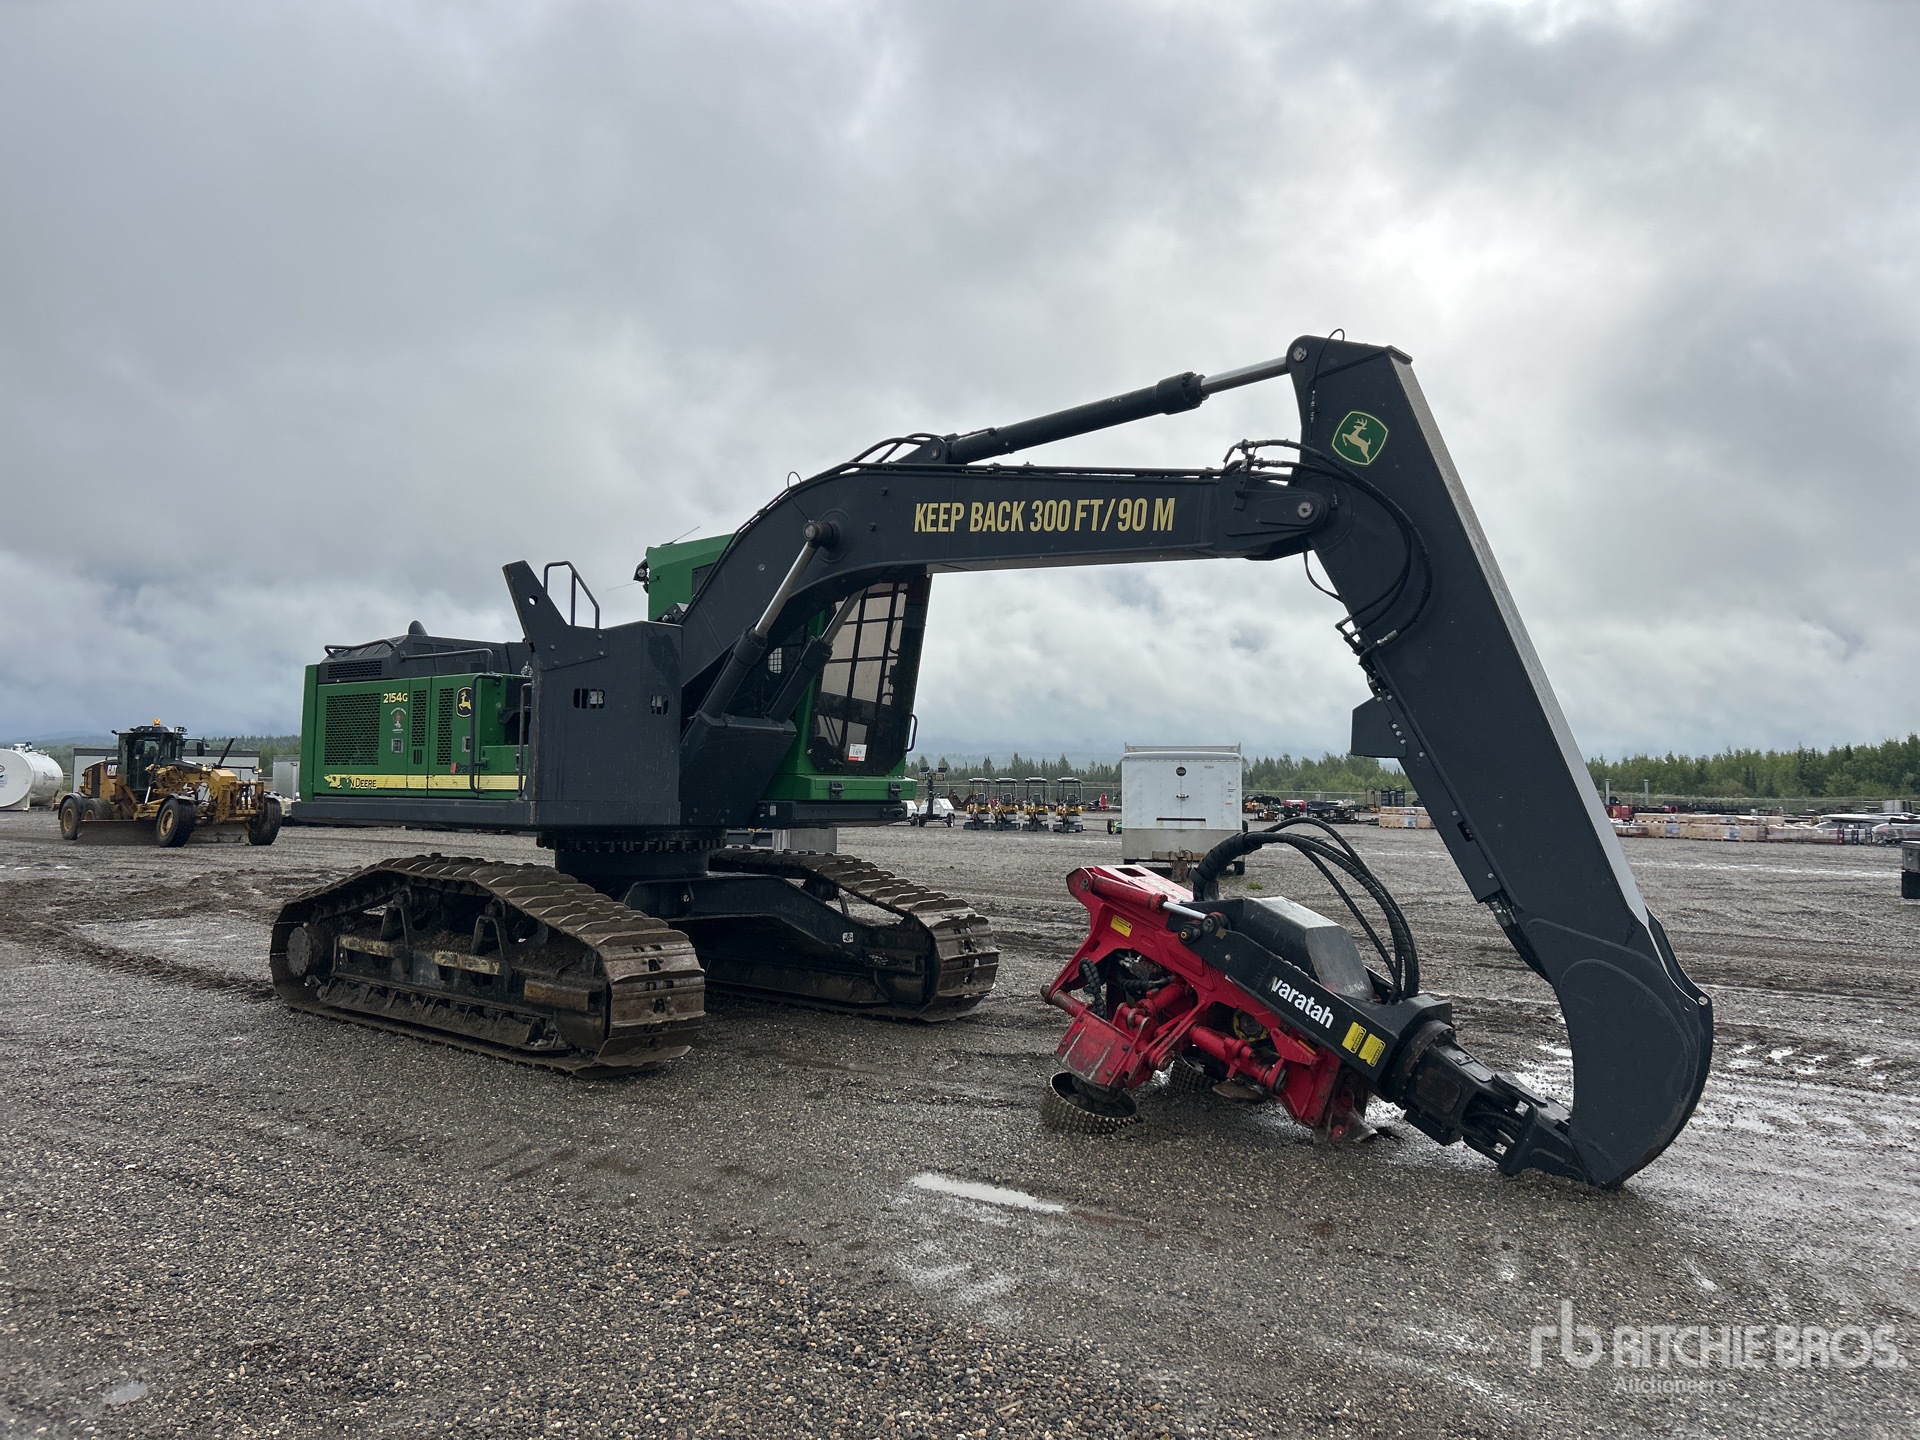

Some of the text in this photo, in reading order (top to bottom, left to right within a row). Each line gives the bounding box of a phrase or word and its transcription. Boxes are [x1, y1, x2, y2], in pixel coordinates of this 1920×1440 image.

[914, 502, 965, 533] KEEP
[969, 501, 1026, 532] BACK
[1029, 500, 1071, 532] 300
[1152, 497, 1176, 531] M
[383, 692, 408, 704] 2154G
[355, 777, 377, 788] DEERE
